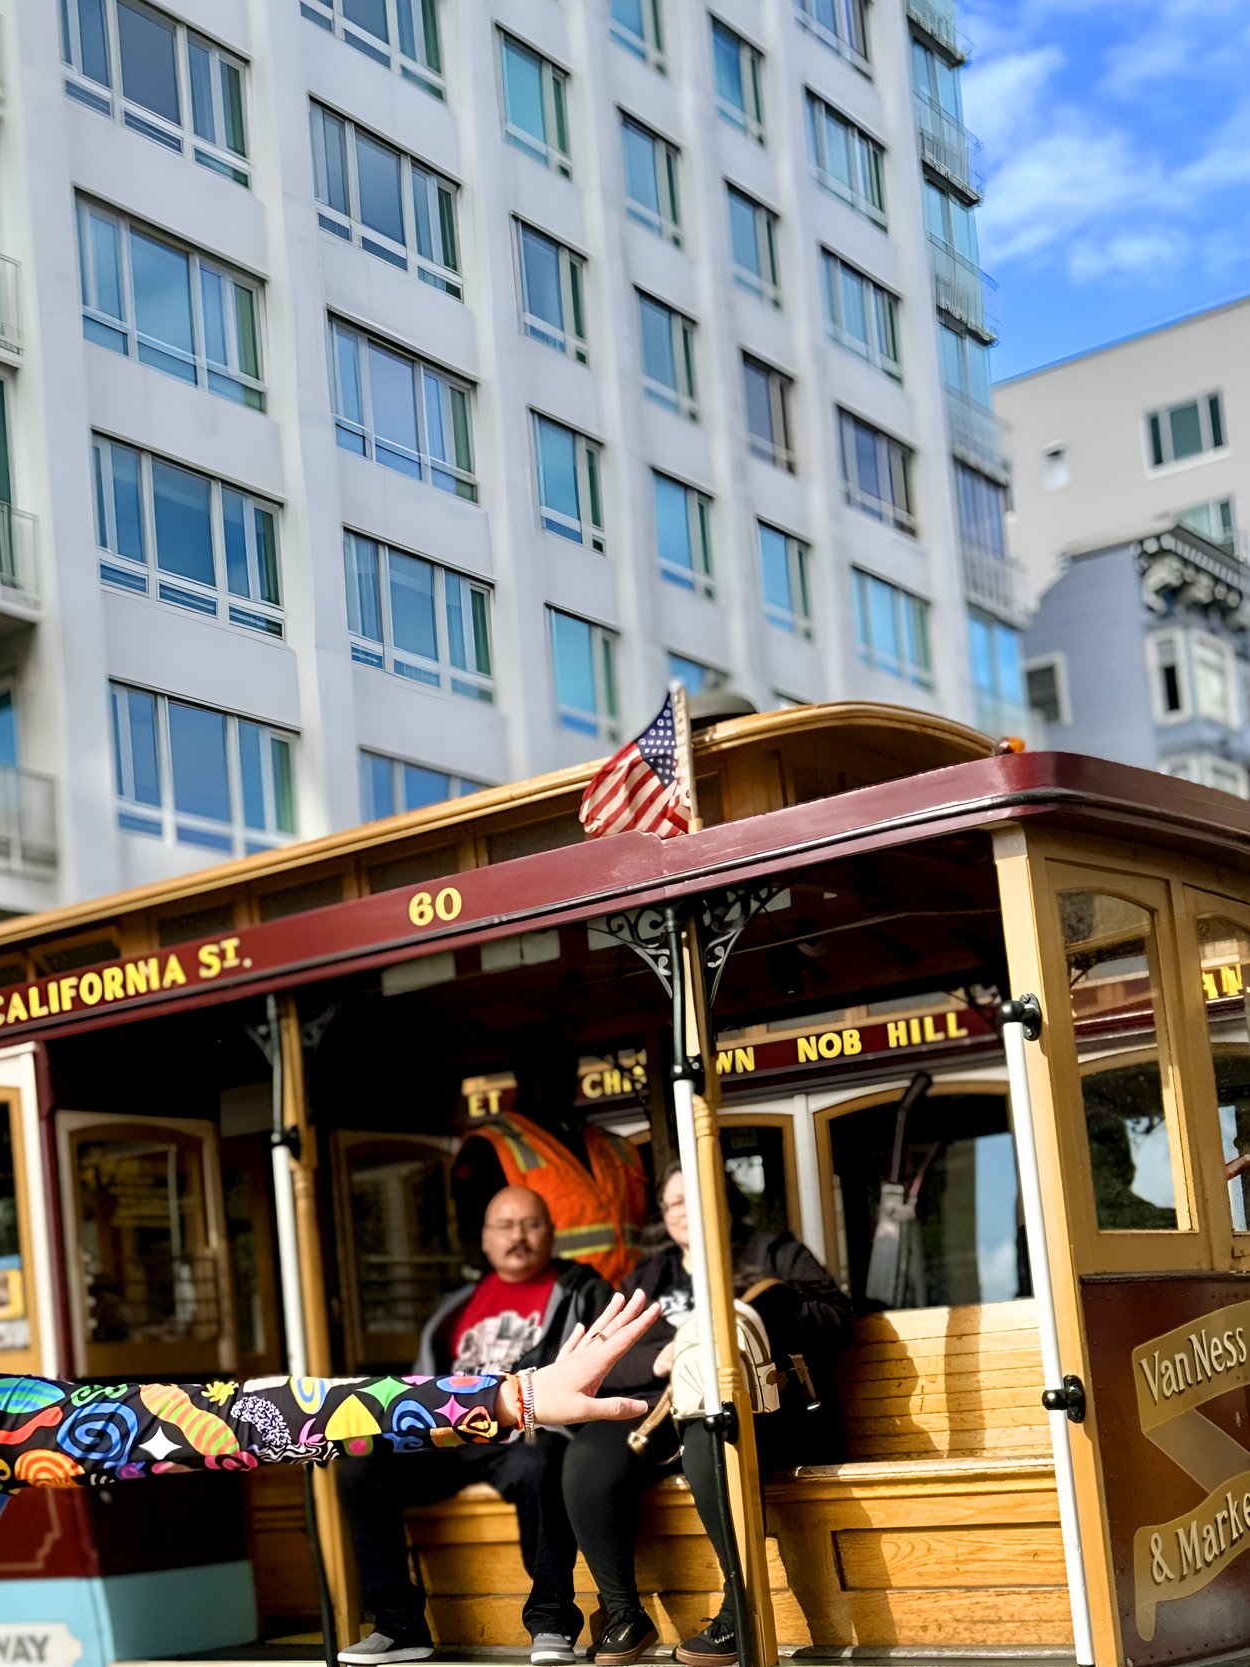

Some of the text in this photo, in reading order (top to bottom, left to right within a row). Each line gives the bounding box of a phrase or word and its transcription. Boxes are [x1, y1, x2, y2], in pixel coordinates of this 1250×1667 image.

[408, 886, 463, 927] 60
[797, 1028, 863, 1064] NOB
[887, 1012, 969, 1049] HILL
[1139, 1325, 1249, 1405] Van Ness
[1150, 1490, 1250, 1585] & Marke
